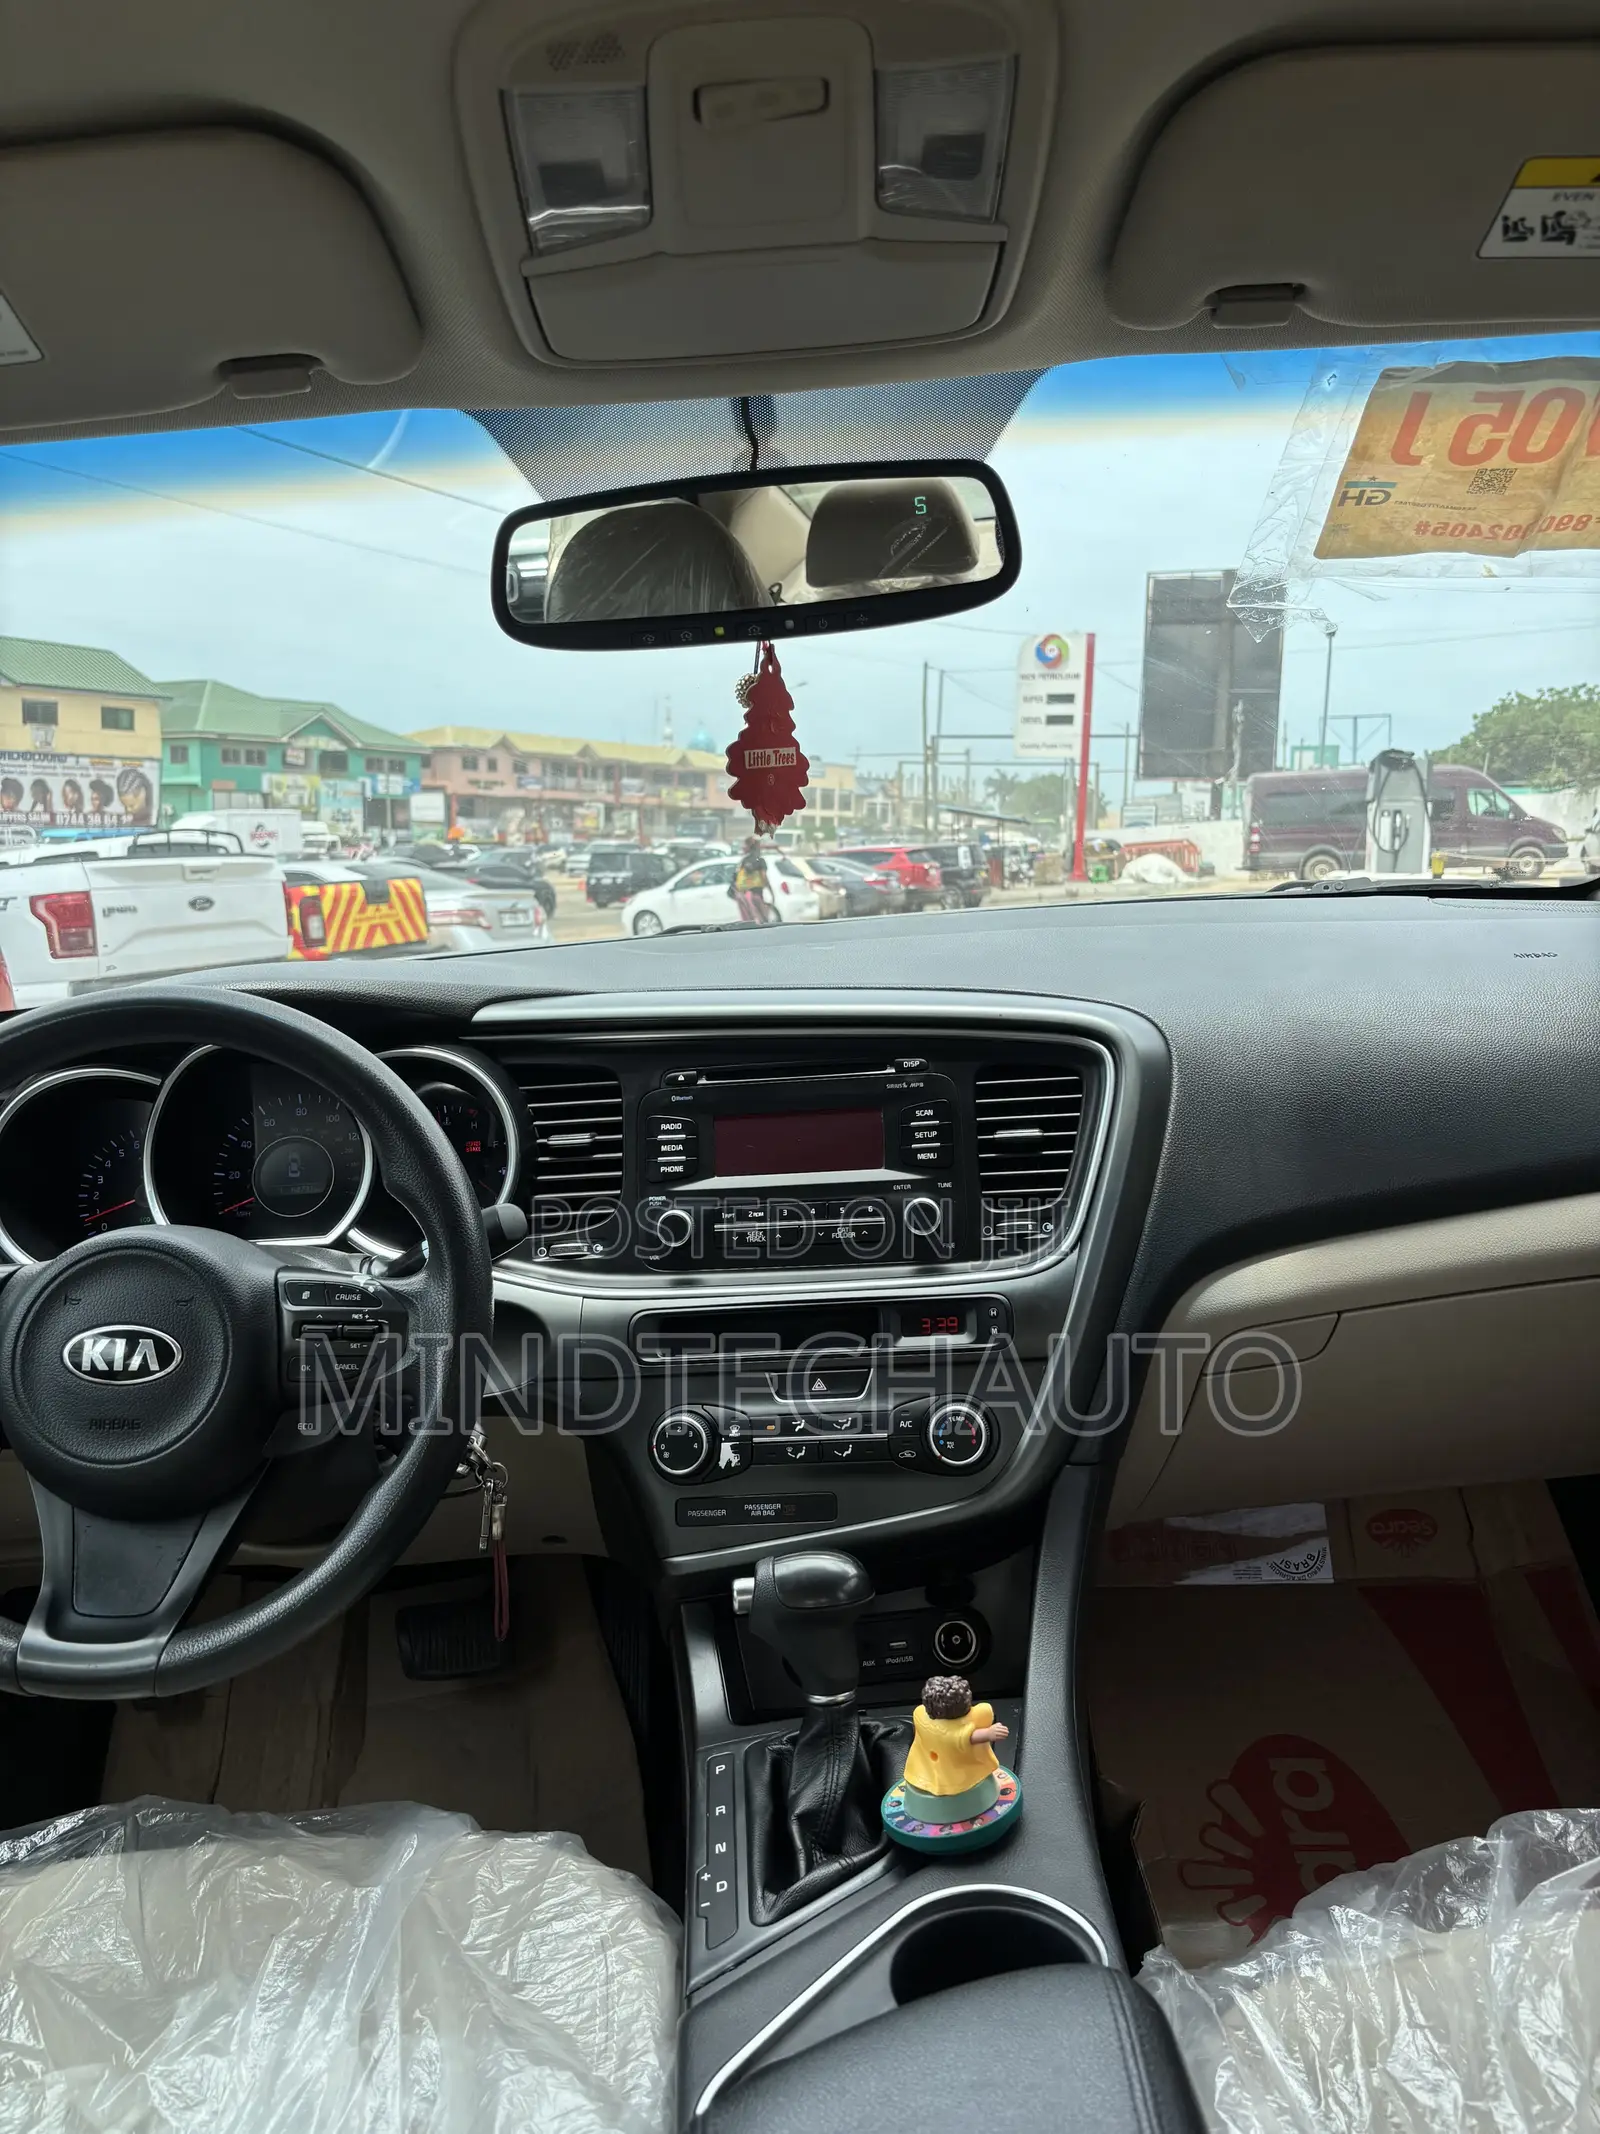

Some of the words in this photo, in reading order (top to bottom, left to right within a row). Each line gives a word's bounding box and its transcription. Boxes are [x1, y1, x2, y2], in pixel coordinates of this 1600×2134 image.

[748, 751, 771, 767] Little
[773, 749, 795, 765] Trees
[1513, 951, 1559, 959] AIRBAG
[903, 1060, 920, 1068] DISP
[295, 1108, 308, 1116] 80
[915, 1109, 934, 1117] SCAN
[263, 1119, 276, 1127] 60
[325, 1115, 340, 1123] 100
[470, 1121, 478, 1129] H
[914, 1131, 938, 1139] SETUP
[133, 1140, 140, 1149] 6
[240, 1141, 253, 1149] 40
[660, 1144, 683, 1152] MEDIA
[118, 1148, 125, 1157] 5
[916, 1152, 937, 1160] MENU
[104, 1160, 112, 1168] 4
[660, 1165, 684, 1173] PHONE
[97, 1175, 104, 1184] 3
[227, 1171, 241, 1180] 20
[93, 1192, 100, 1200] 2
[867, 1205, 874, 1213] 6
[101, 1222, 108, 1231] 0
[335, 1293, 362, 1301] CRUISE
[920, 1316, 959, 1335] 3:39
[81, 1338, 160, 1371] KIA
[301, 1364, 312, 1372] OK
[334, 1363, 359, 1371] CANCEL
[948, 1415, 965, 1423] TEMP
[88, 1417, 142, 1430] AIRBAG
[297, 1422, 313, 1431] ECO
[899, 1420, 913, 1428] A/C
[744, 1503, 781, 1511] PASSENGER
[687, 1508, 727, 1517] PASSENGER
[1371, 1516, 1434, 1536] Seara
[862, 1659, 876, 1667] AUX
[885, 1655, 914, 1665] iPod/USB
[715, 1764, 726, 1775] P
[715, 1805, 726, 1816] R
[715, 1842, 726, 1854] N
[716, 1880, 728, 1893] D
